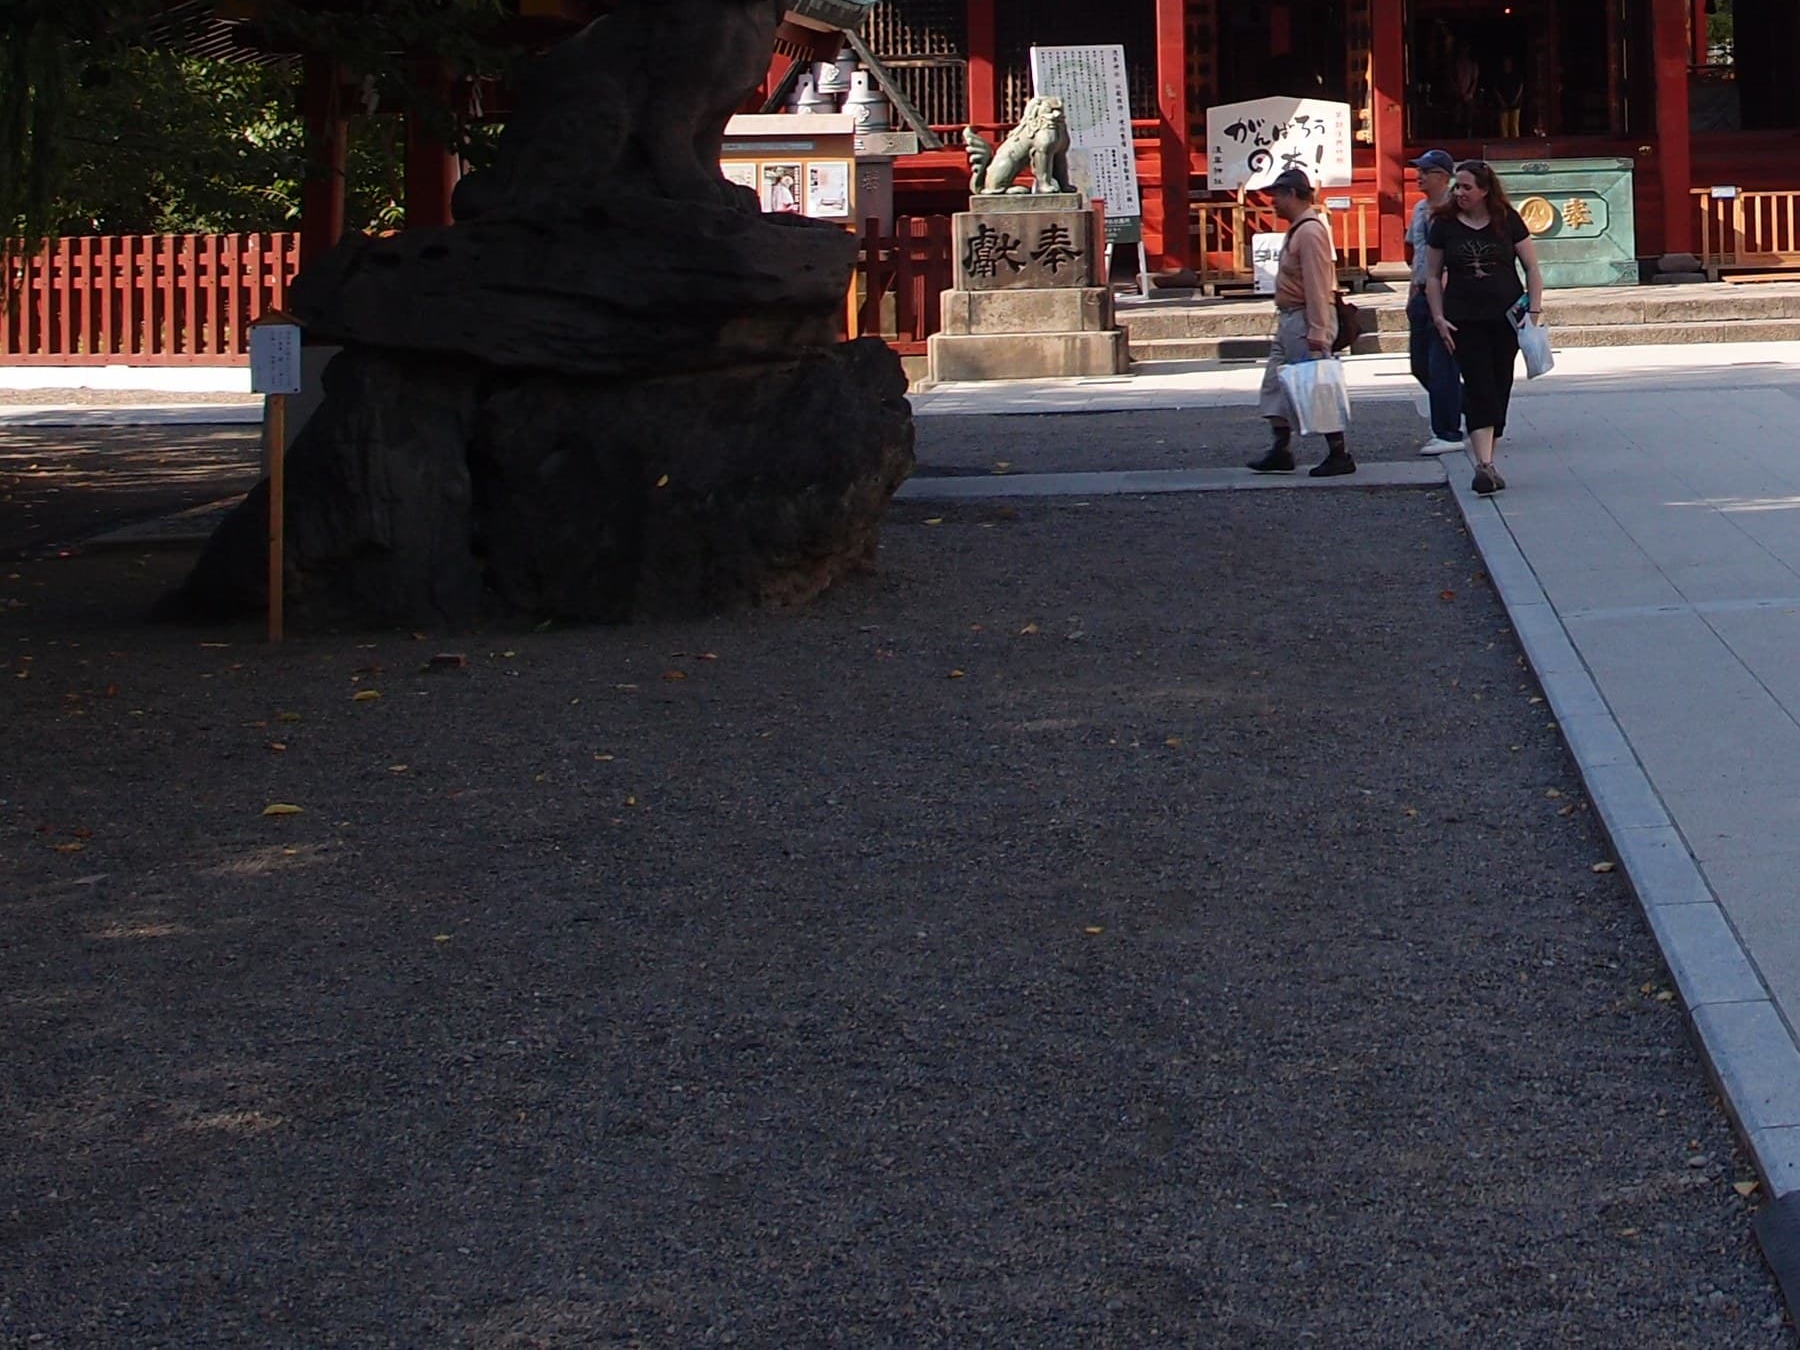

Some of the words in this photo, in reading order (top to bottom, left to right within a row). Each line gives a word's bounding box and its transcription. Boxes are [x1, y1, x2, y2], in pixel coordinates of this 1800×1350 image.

[1223, 114, 1326, 147] がんばろう
[1562, 197, 1593, 230] 奉
